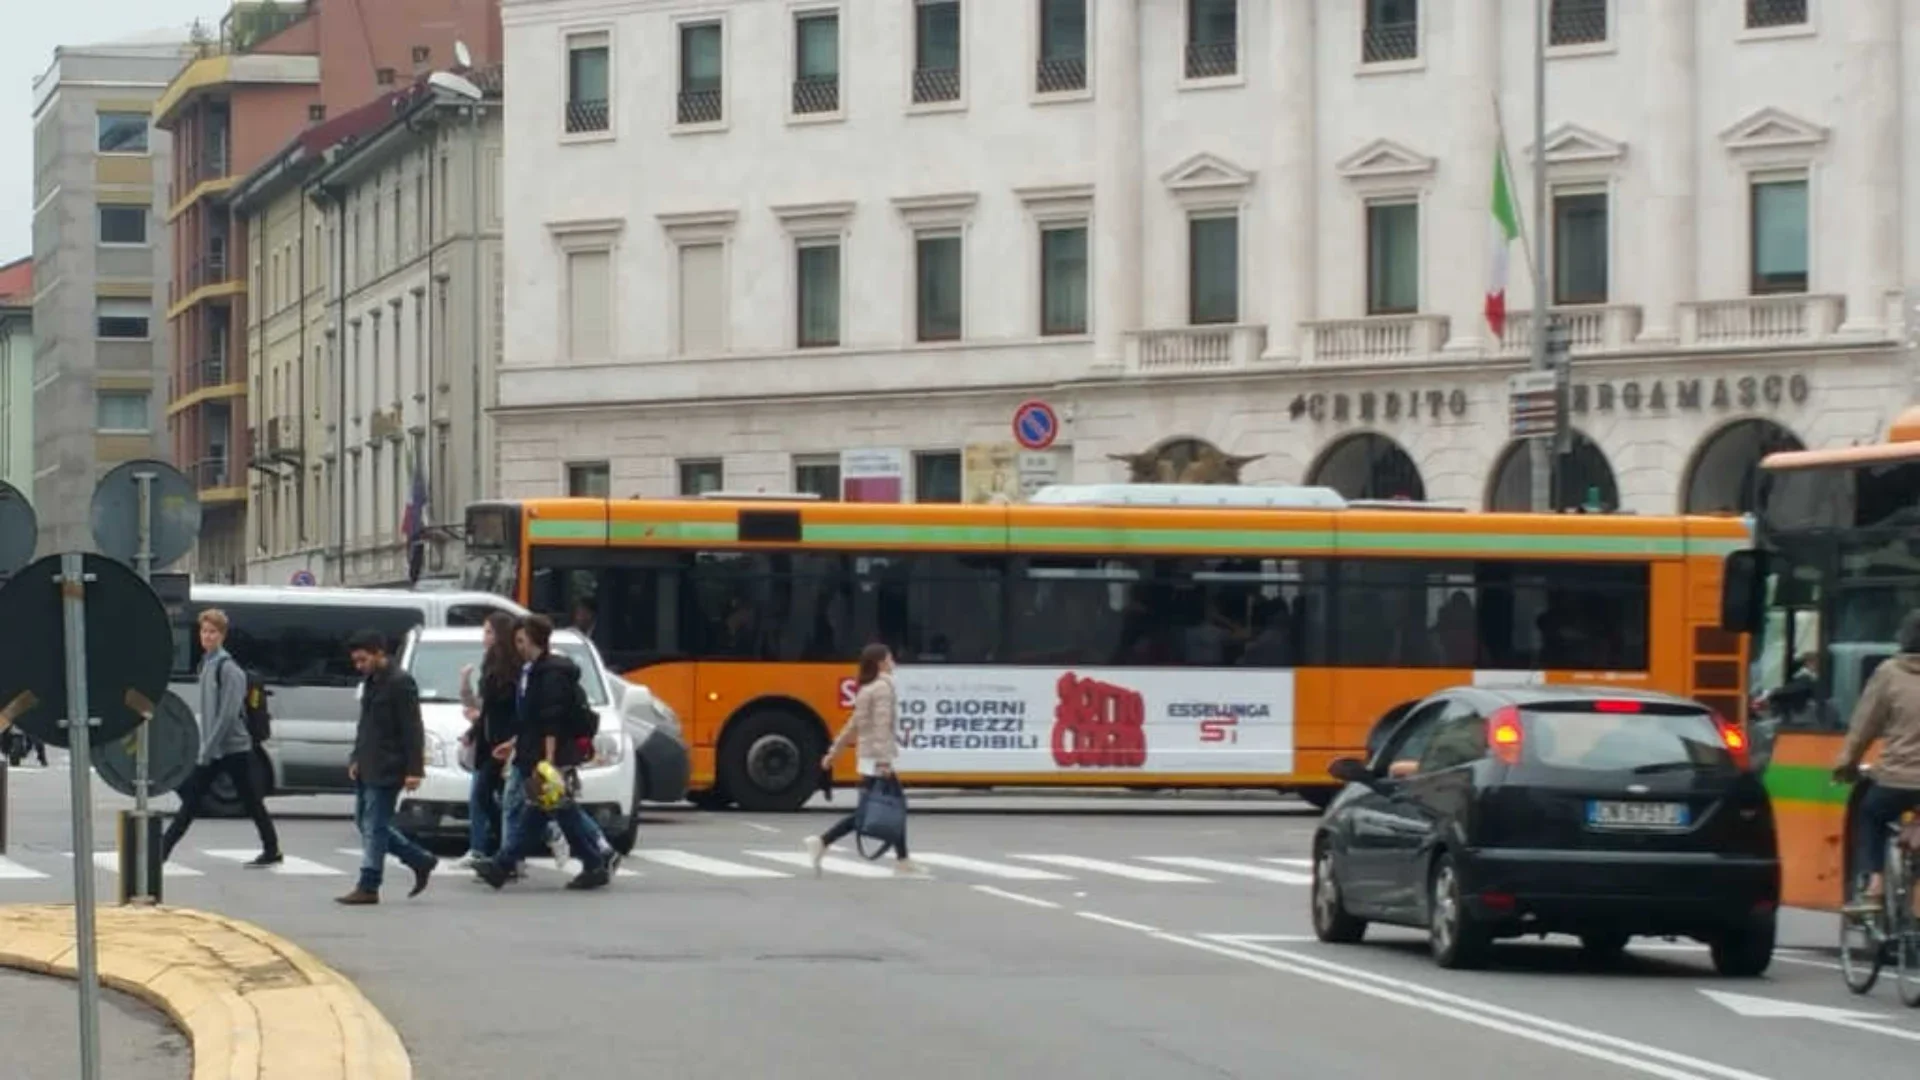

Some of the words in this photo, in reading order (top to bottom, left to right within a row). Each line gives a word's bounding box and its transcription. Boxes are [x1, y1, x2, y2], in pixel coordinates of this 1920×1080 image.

[1308, 389, 1467, 422] CREDITO
[1570, 374, 1808, 413] ERGAMASCO
[900, 699, 927, 715] 10
[935, 699, 1027, 715] GIORNI
[1167, 703, 1270, 718] ESSELUNGA
[934, 717, 1024, 733] PREZZI
[896, 734, 1039, 750] NCREDIBILI
